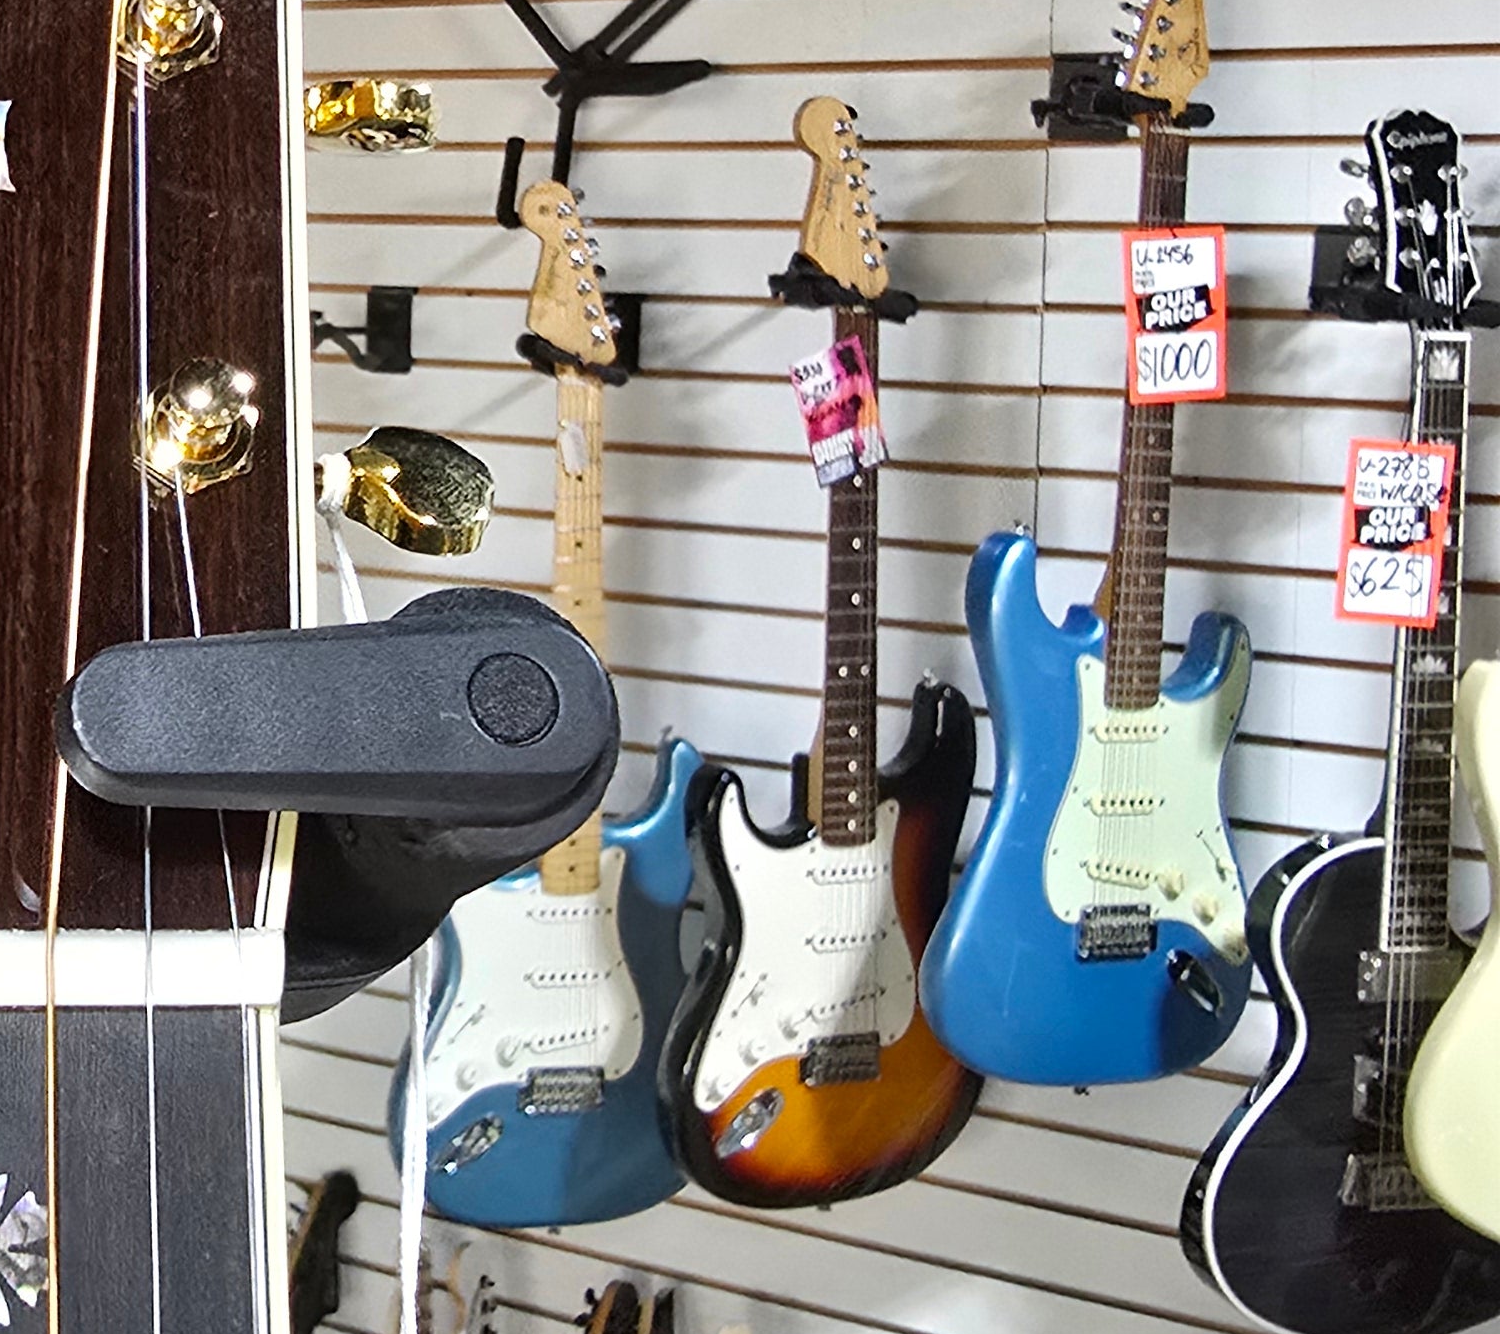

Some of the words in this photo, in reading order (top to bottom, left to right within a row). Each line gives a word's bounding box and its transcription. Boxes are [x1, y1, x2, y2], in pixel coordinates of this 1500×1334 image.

[1151, 287, 1196, 311] OUR
[1145, 301, 1208, 330] PRICE
[1138, 338, 1213, 388] $1000
[1369, 508, 1417, 526] OUR
[1360, 522, 1426, 544] PRICE
[1348, 556, 1423, 599] $625
